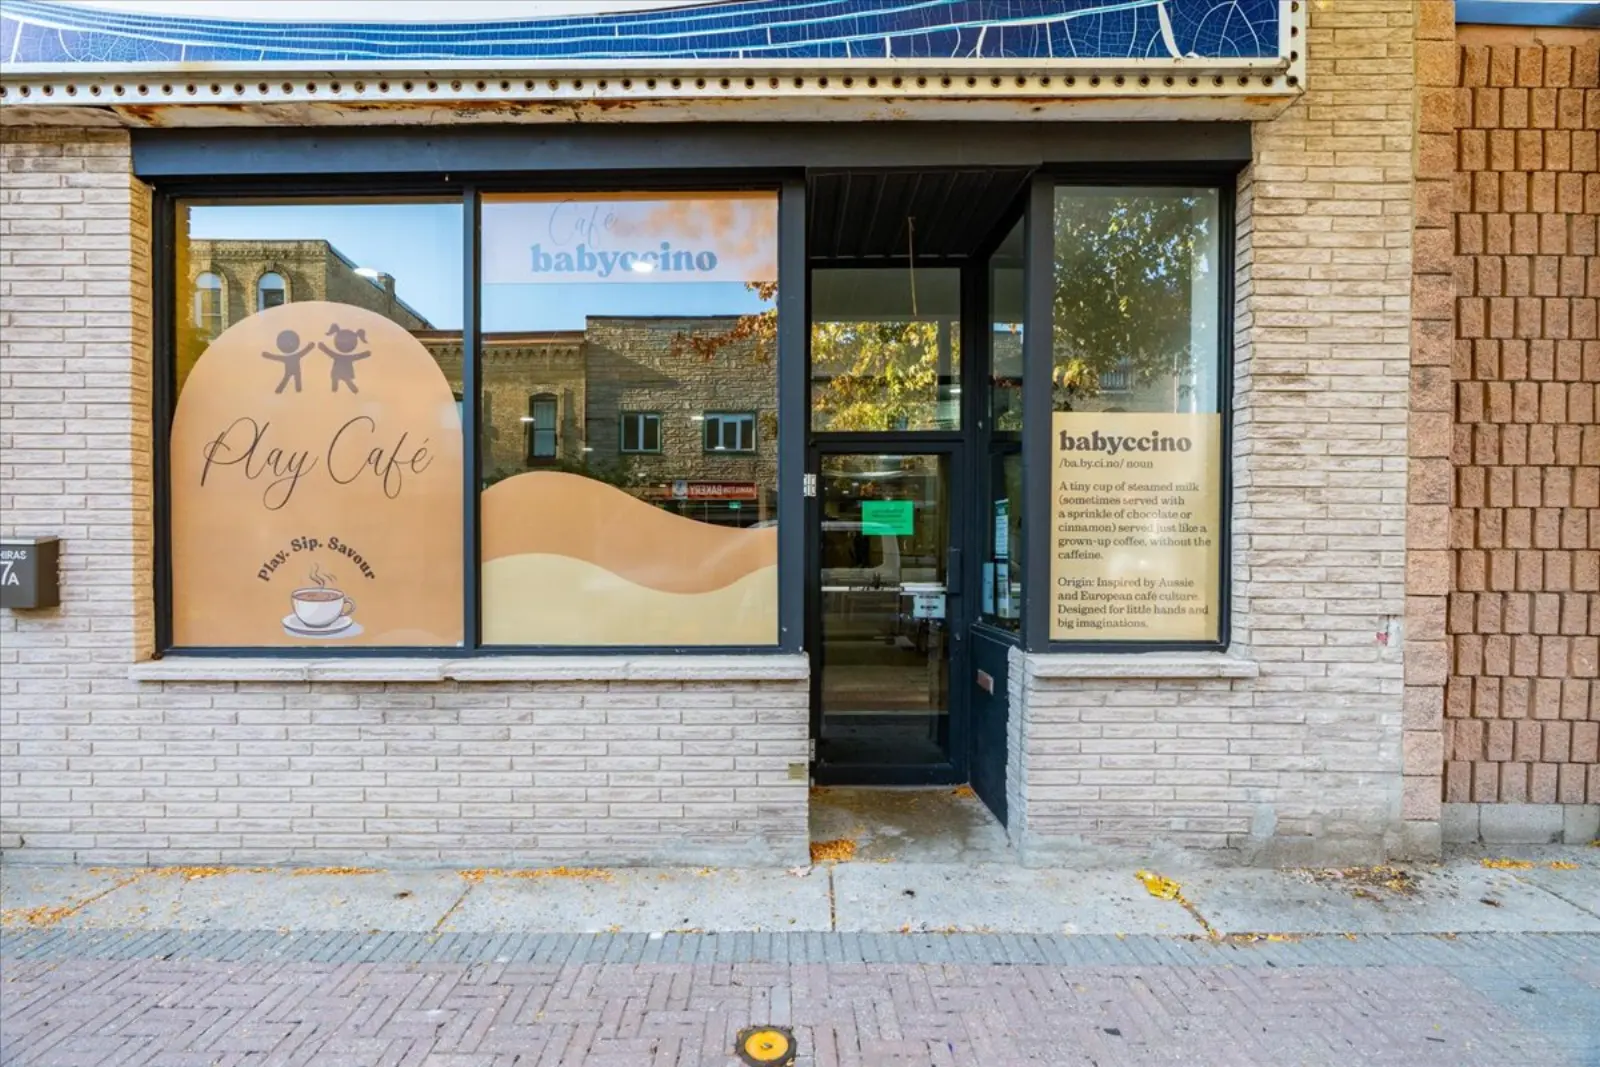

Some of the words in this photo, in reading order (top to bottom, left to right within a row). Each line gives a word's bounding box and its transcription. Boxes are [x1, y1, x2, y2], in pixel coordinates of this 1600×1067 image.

[547, 199, 618, 248] Café
[530, 242, 718, 277] babyccino
[1059, 430, 1192, 455] babyccino
[200, 416, 319, 511] Play
[327, 415, 434, 500] Café
[1059, 458, 1124, 469] /ba.by.ci.no/
[1126, 461, 1153, 469] noun
[1060, 482, 1069, 491] A
[1070, 482, 1090, 493] tiny
[1093, 484, 1112, 494] cup
[1114, 482, 1126, 491] of
[1127, 482, 1173, 491] steamed
[1175, 482, 1199, 491] milk
[1058, 495, 1121, 505] (sometimes
[1123, 496, 1158, 505] served
[1161, 495, 1184, 505] with
[1067, 508, 1113, 520] sprinkle
[1114, 508, 1125, 518] of
[1127, 508, 1178, 519] chocolate
[1180, 511, 1192, 519] or
[1058, 523, 1116, 533] cinnamon)
[1118, 523, 1153, 532] served
[1155, 524, 1176, 535] just
[1178, 523, 1198, 532] like
[1058, 537, 1111, 548] grown-up
[1113, 536, 1147, 547] coffee,
[1150, 536, 1191, 546] without
[1194, 536, 1211, 546] the
[257, 549, 290, 582] Play.
[290, 536, 323, 552] Sip.
[327, 536, 376, 580] Savour
[1058, 550, 1103, 560] caffeine.
[1058, 577, 1095, 588] Origin:
[1097, 577, 1141, 588] Inspired
[1143, 577, 1155, 588] by
[1159, 578, 1194, 587] Aussie
[1058, 591, 1078, 601] and
[1080, 591, 1133, 602] European
[1134, 591, 1157, 600] café
[1058, 605, 1107, 615] Designed
[1109, 604, 1125, 614] for
[1127, 604, 1151, 614] little
[1154, 604, 1186, 614] hands
[1188, 605, 1208, 614] and
[1058, 618, 1074, 629] big
[1076, 618, 1148, 629] imaginations.
